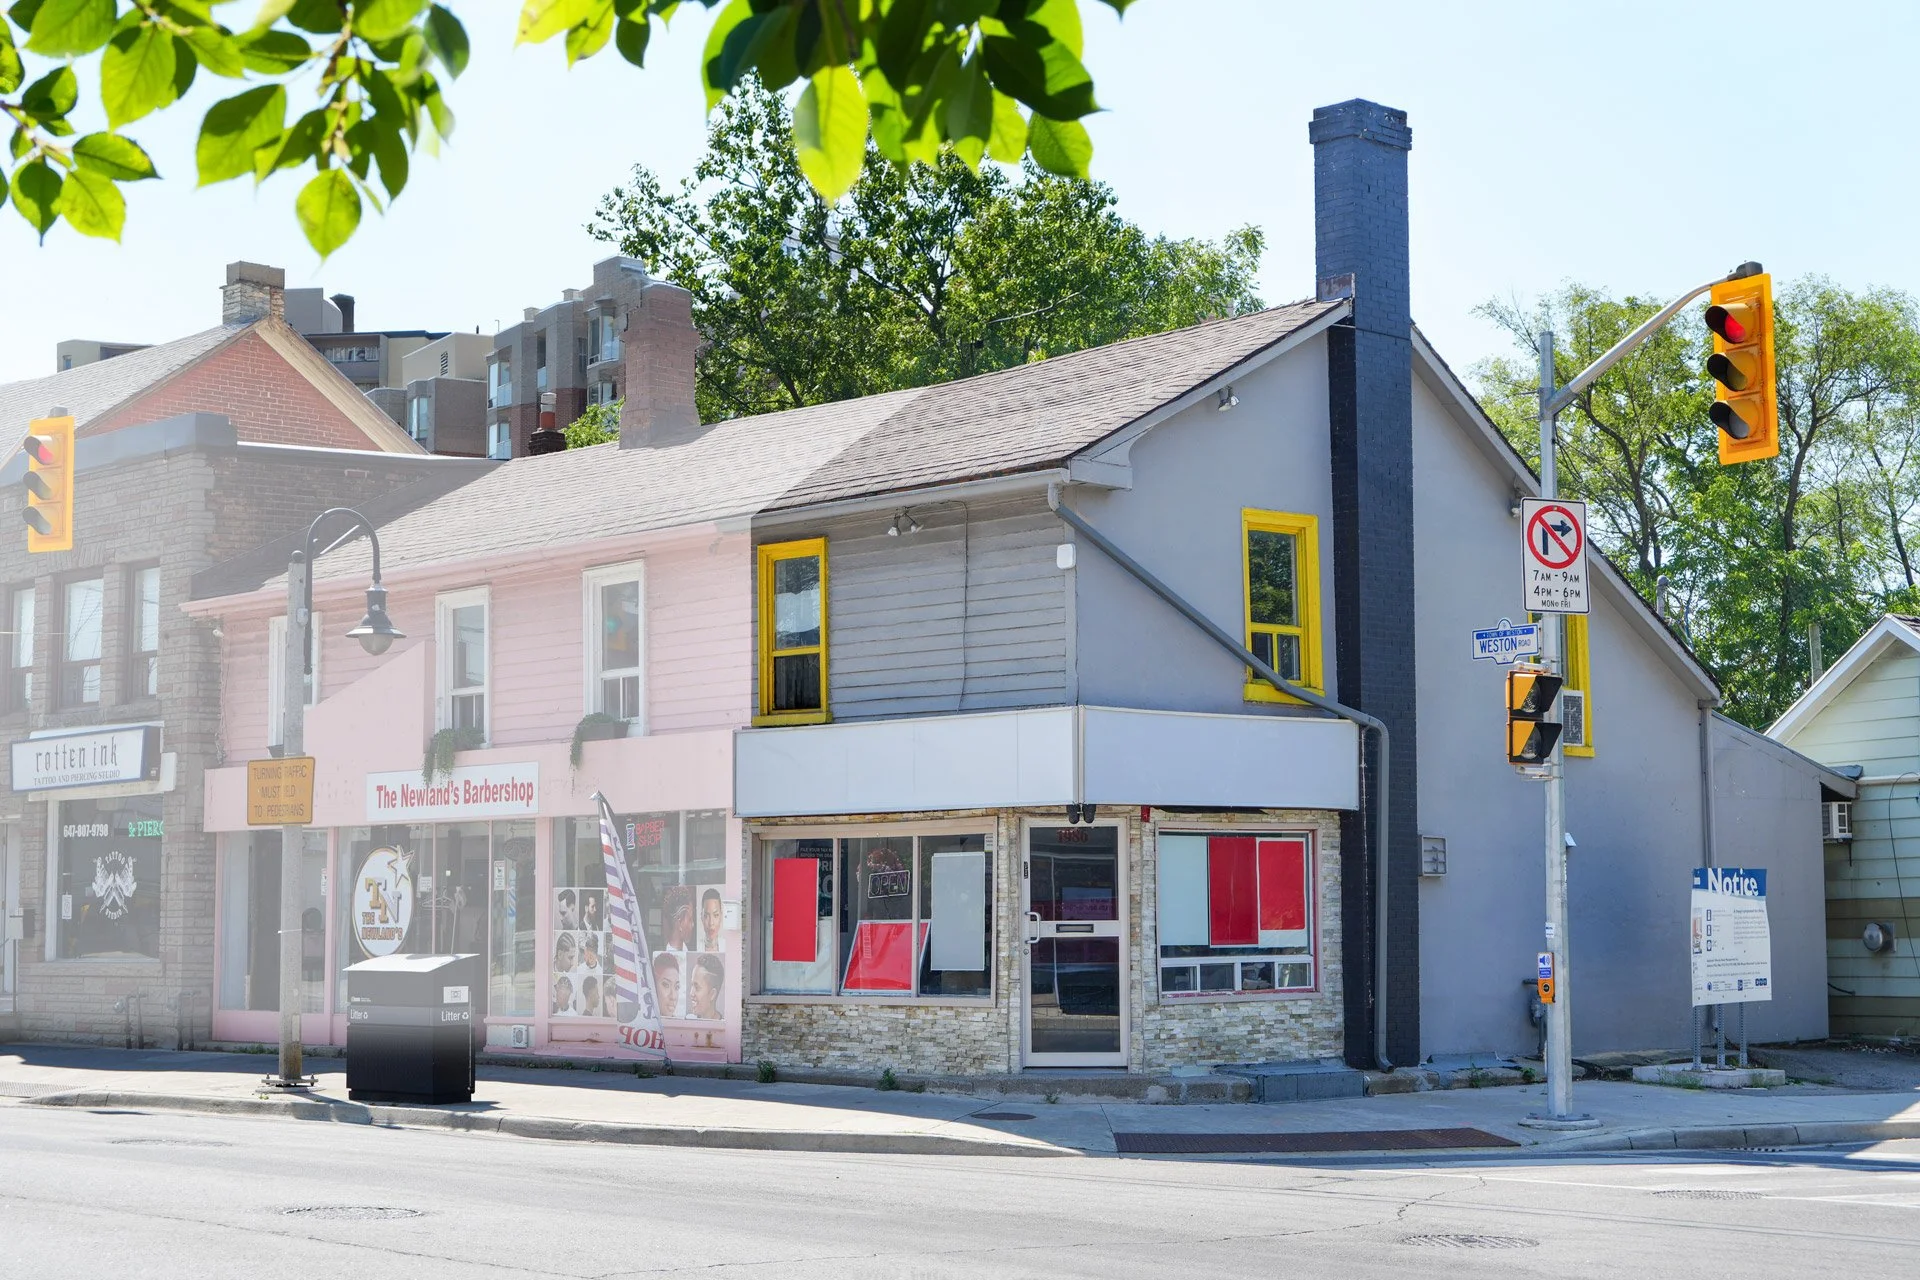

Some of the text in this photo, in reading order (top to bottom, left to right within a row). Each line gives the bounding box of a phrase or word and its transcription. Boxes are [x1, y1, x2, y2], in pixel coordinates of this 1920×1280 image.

[1533, 570, 1551, 581] 7AM
[1562, 571, 1580, 583] 9AM
[1533, 585, 1552, 597] 4PM
[1563, 587, 1581, 598] 6PM
[1480, 637, 1518, 653] WESTON
[36, 736, 118, 772] rotten ink
[34, 769, 121, 785] TATTOO AND PIERCING STUDIO
[253, 767, 282, 779] TURNING
[262, 786, 280, 798] MUST
[376, 776, 534, 808] The Newland's Barbershop
[254, 804, 262, 818] TO
[636, 819, 665, 835] BARBER
[638, 833, 662, 847] SHOP
[870, 872, 907, 896] OPEN
[1708, 868, 1759, 896] Notice
[441, 1010, 461, 1021] Litter
